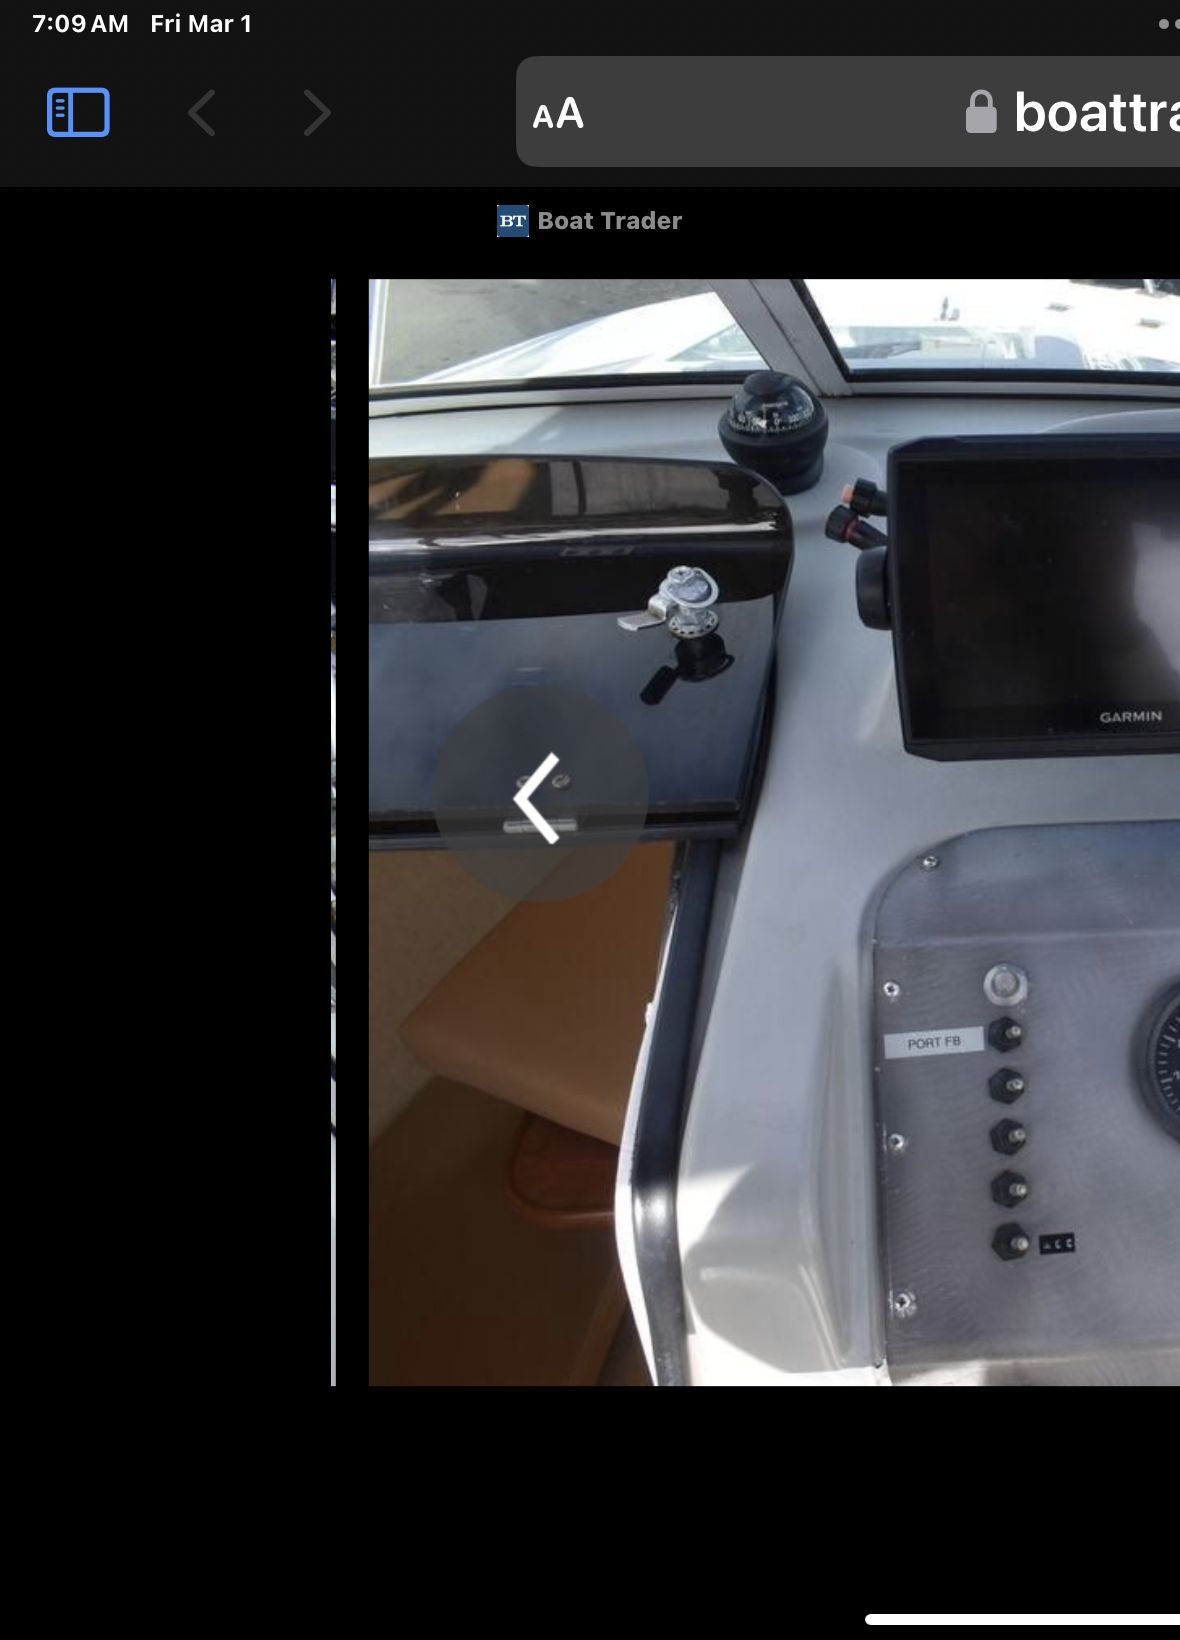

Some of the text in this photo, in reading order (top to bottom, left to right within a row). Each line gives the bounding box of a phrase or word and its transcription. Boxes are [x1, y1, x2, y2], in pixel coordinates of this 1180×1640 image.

[33, 14, 127, 33] 7:09 AM
[152, 13, 251, 33] Fri Mar 1
[499, 215, 527, 227] BT
[538, 211, 683, 230] Boat Trader
[1099, 711, 1163, 723] GARMIN
[908, 1035, 962, 1051] PORT FB
[1173, 1070, 1180, 1080] 1
